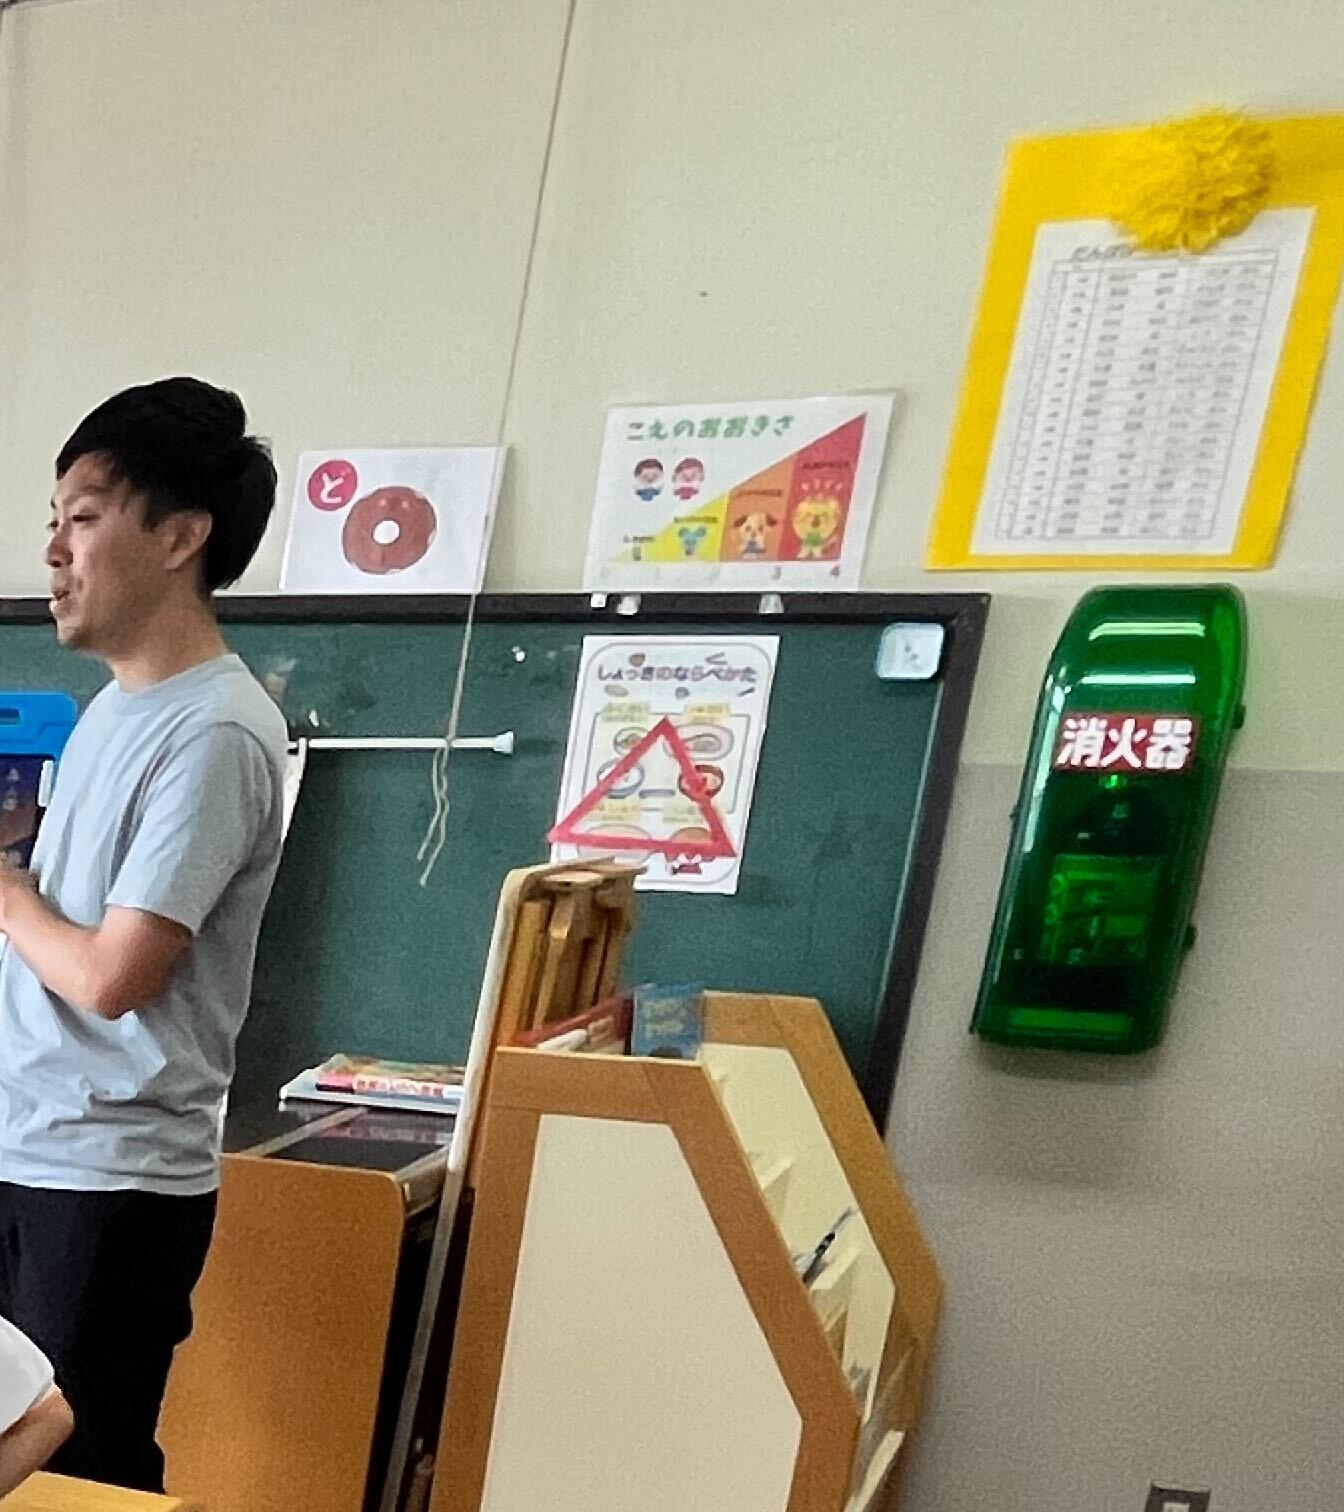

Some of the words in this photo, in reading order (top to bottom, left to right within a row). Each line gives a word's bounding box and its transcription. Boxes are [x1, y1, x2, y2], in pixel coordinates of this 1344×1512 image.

[627, 414, 795, 441] こえのおおきさ
[320, 468, 352, 504] ど
[1056, 717, 1193, 770] 消火器
